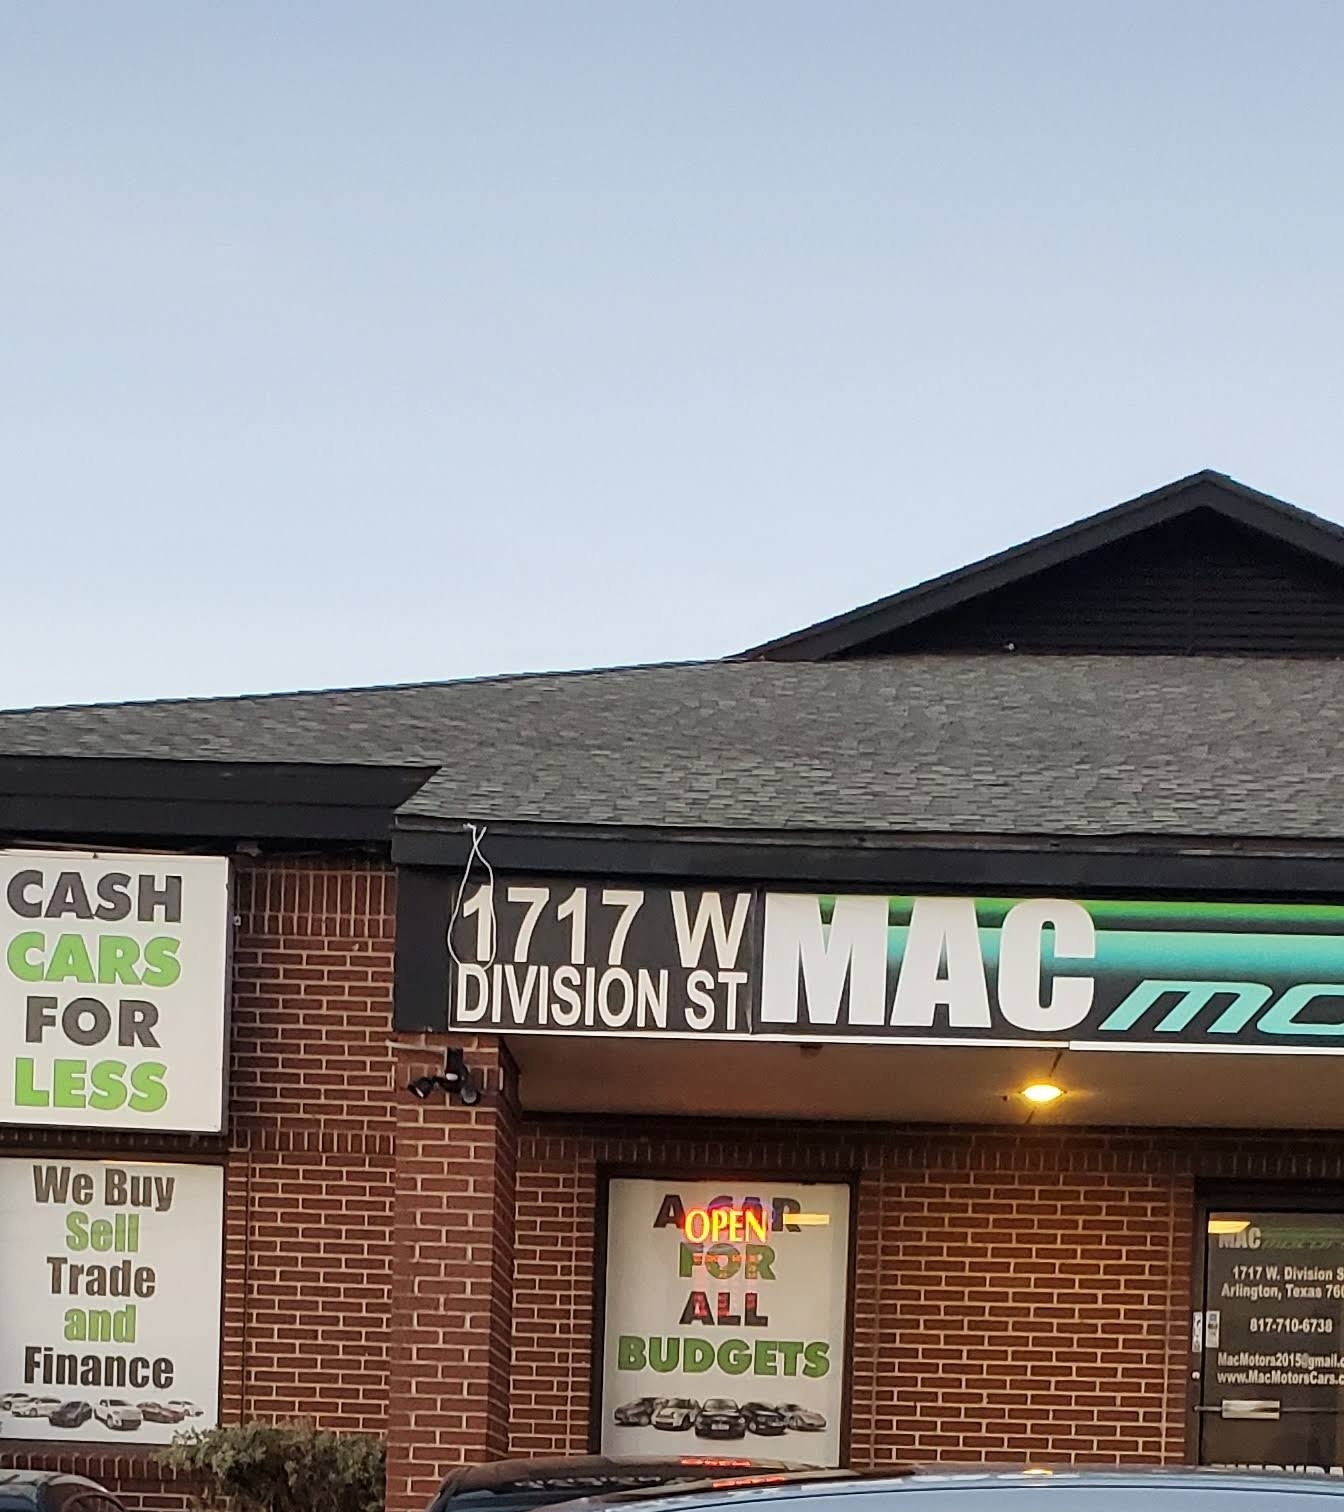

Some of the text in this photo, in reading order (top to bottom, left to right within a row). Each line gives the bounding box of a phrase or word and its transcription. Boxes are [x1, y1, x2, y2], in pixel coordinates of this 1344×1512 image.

[6, 869, 183, 923] CASH
[462, 884, 752, 969] 1717 W
[6, 931, 182, 987] CARS
[760, 891, 1096, 1032] MAC
[456, 963, 748, 1031] DIVISION ST
[24, 996, 161, 1048] FOR
[14, 1057, 168, 1113] LESS
[32, 1164, 175, 1212] We Buy
[65, 1211, 140, 1253] Sell
[653, 1194, 685, 1230] A
[684, 1208, 769, 1244] OPEN
[46, 1256, 156, 1298] Trade
[678, 1242, 776, 1280] FOR
[1232, 1266, 1263, 1280] 1717
[1266, 1266, 1281, 1281] W.
[1284, 1266, 1333, 1281] Division
[678, 1290, 769, 1327] ALL
[1221, 1283, 1282, 1300] Arlington,
[1286, 1284, 1322, 1299] Texas
[63, 1304, 137, 1344] and
[1249, 1318, 1333, 1333] 817-710-6738
[23, 1346, 174, 1389] Finance
[617, 1335, 830, 1379] BUDGETS
